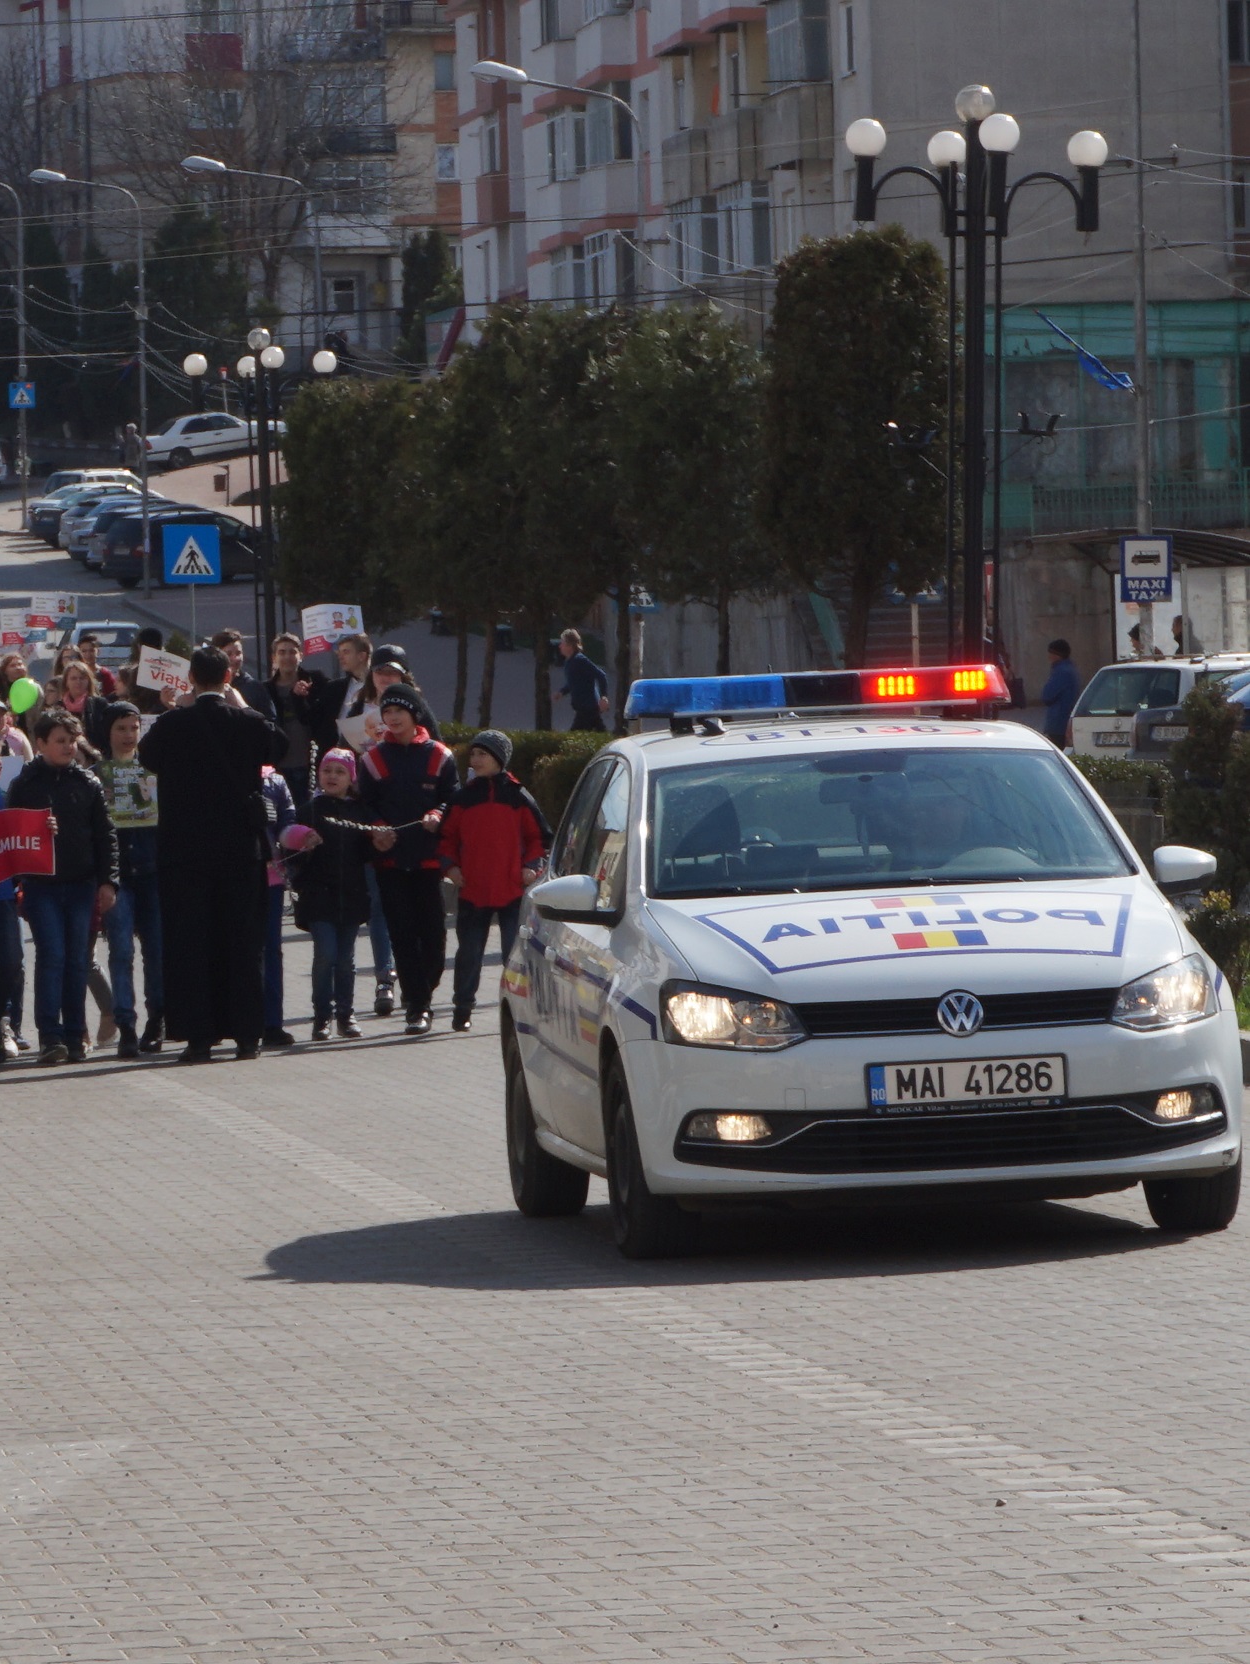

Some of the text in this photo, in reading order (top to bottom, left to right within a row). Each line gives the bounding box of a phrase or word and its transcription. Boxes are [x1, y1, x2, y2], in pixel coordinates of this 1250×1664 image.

[1127, 580, 1166, 590] MAXI
[895, 1061, 1053, 1100] MAI 41286
[871, 1088, 886, 1101] RO
